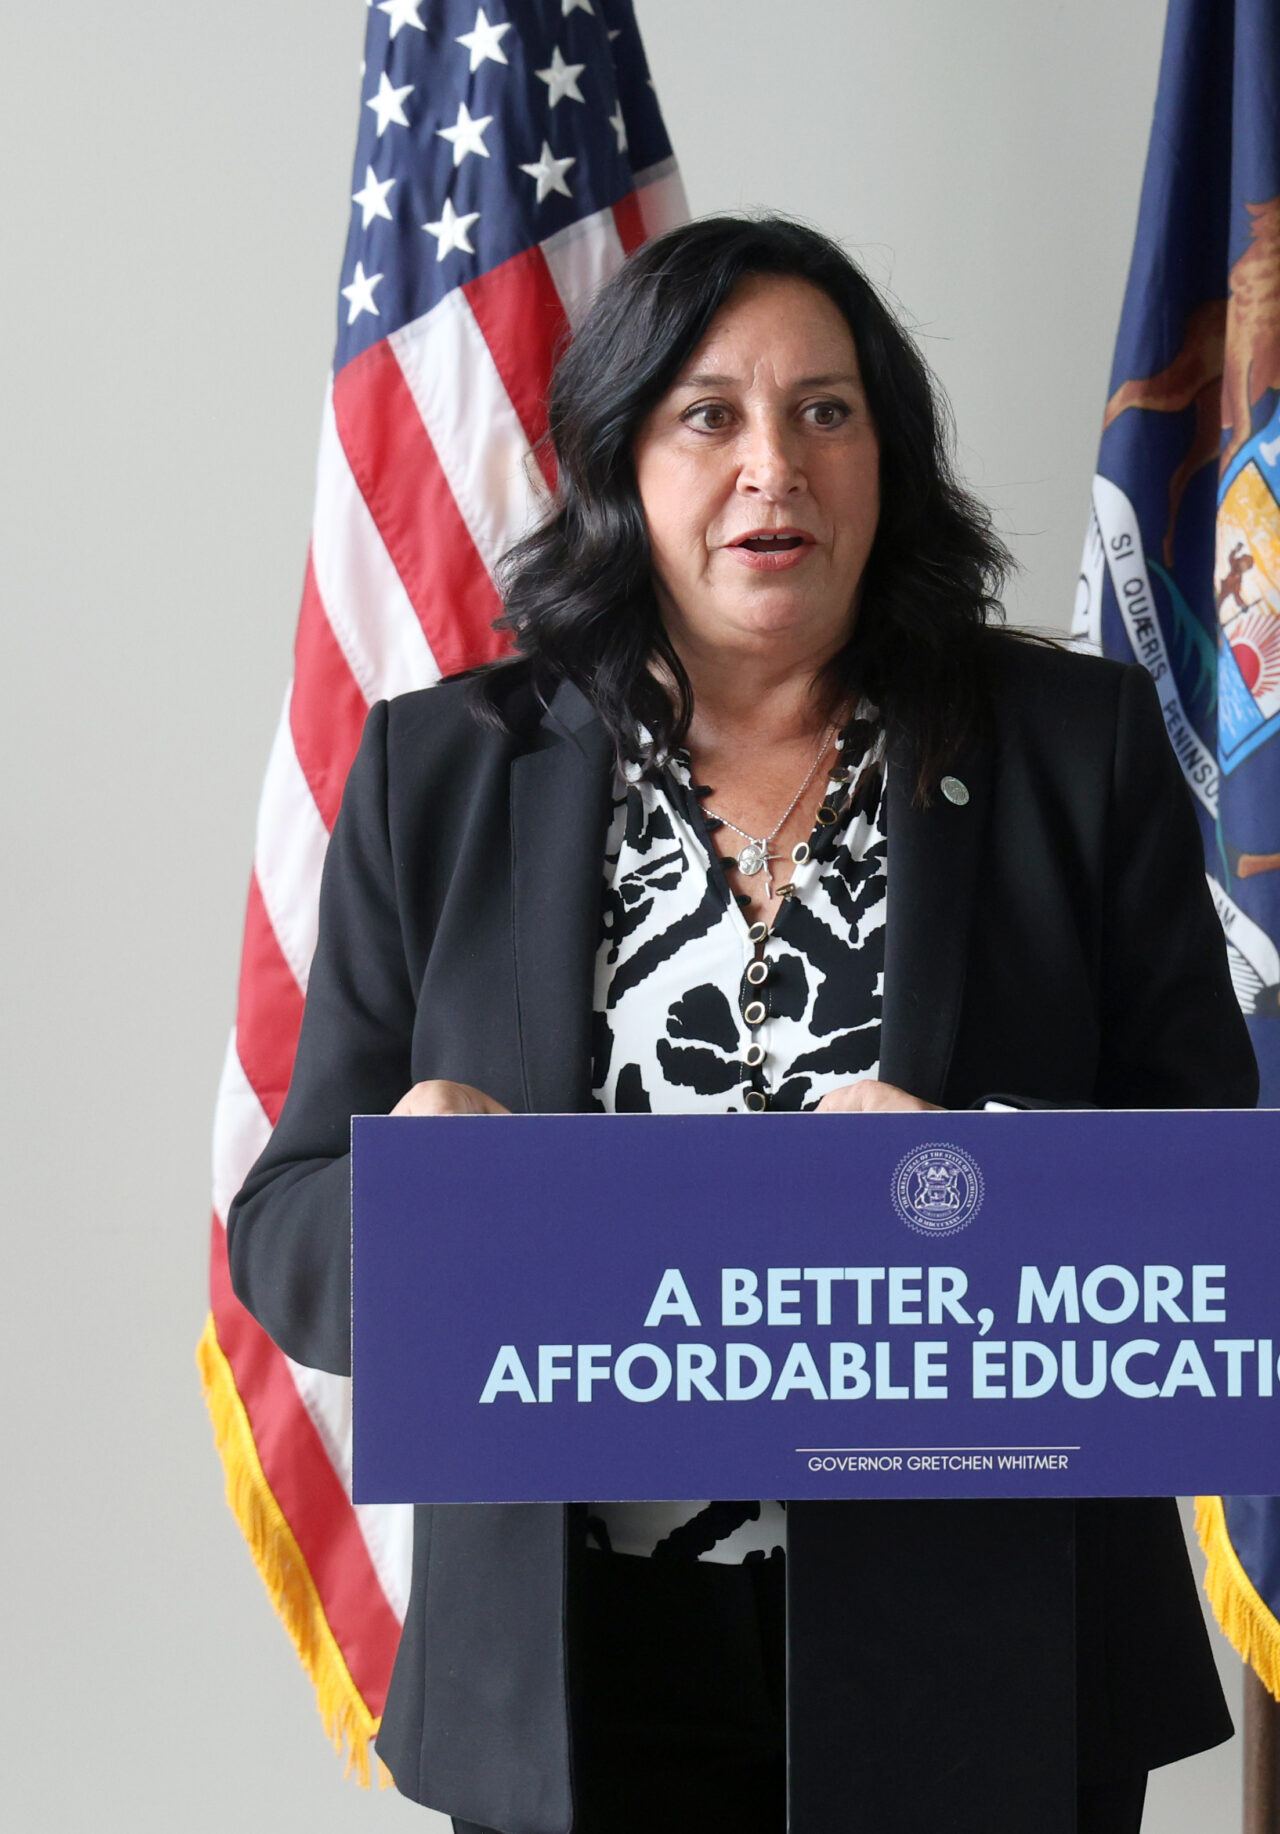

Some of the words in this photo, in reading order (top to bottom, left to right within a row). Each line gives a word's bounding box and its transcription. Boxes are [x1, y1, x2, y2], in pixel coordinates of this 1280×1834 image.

[1110, 533, 1135, 561] SI
[1164, 699, 1219, 801] PENINSU
[644, 1268, 702, 1327] A
[722, 1266, 995, 1338] BETTER,
[1017, 1264, 1227, 1325] MORE
[479, 1341, 948, 1404] AFFORDABLE
[808, 1457, 903, 1472] GOVERNOR
[907, 1456, 993, 1471] GRETCHEN
[997, 1455, 1069, 1470] WHITMER
